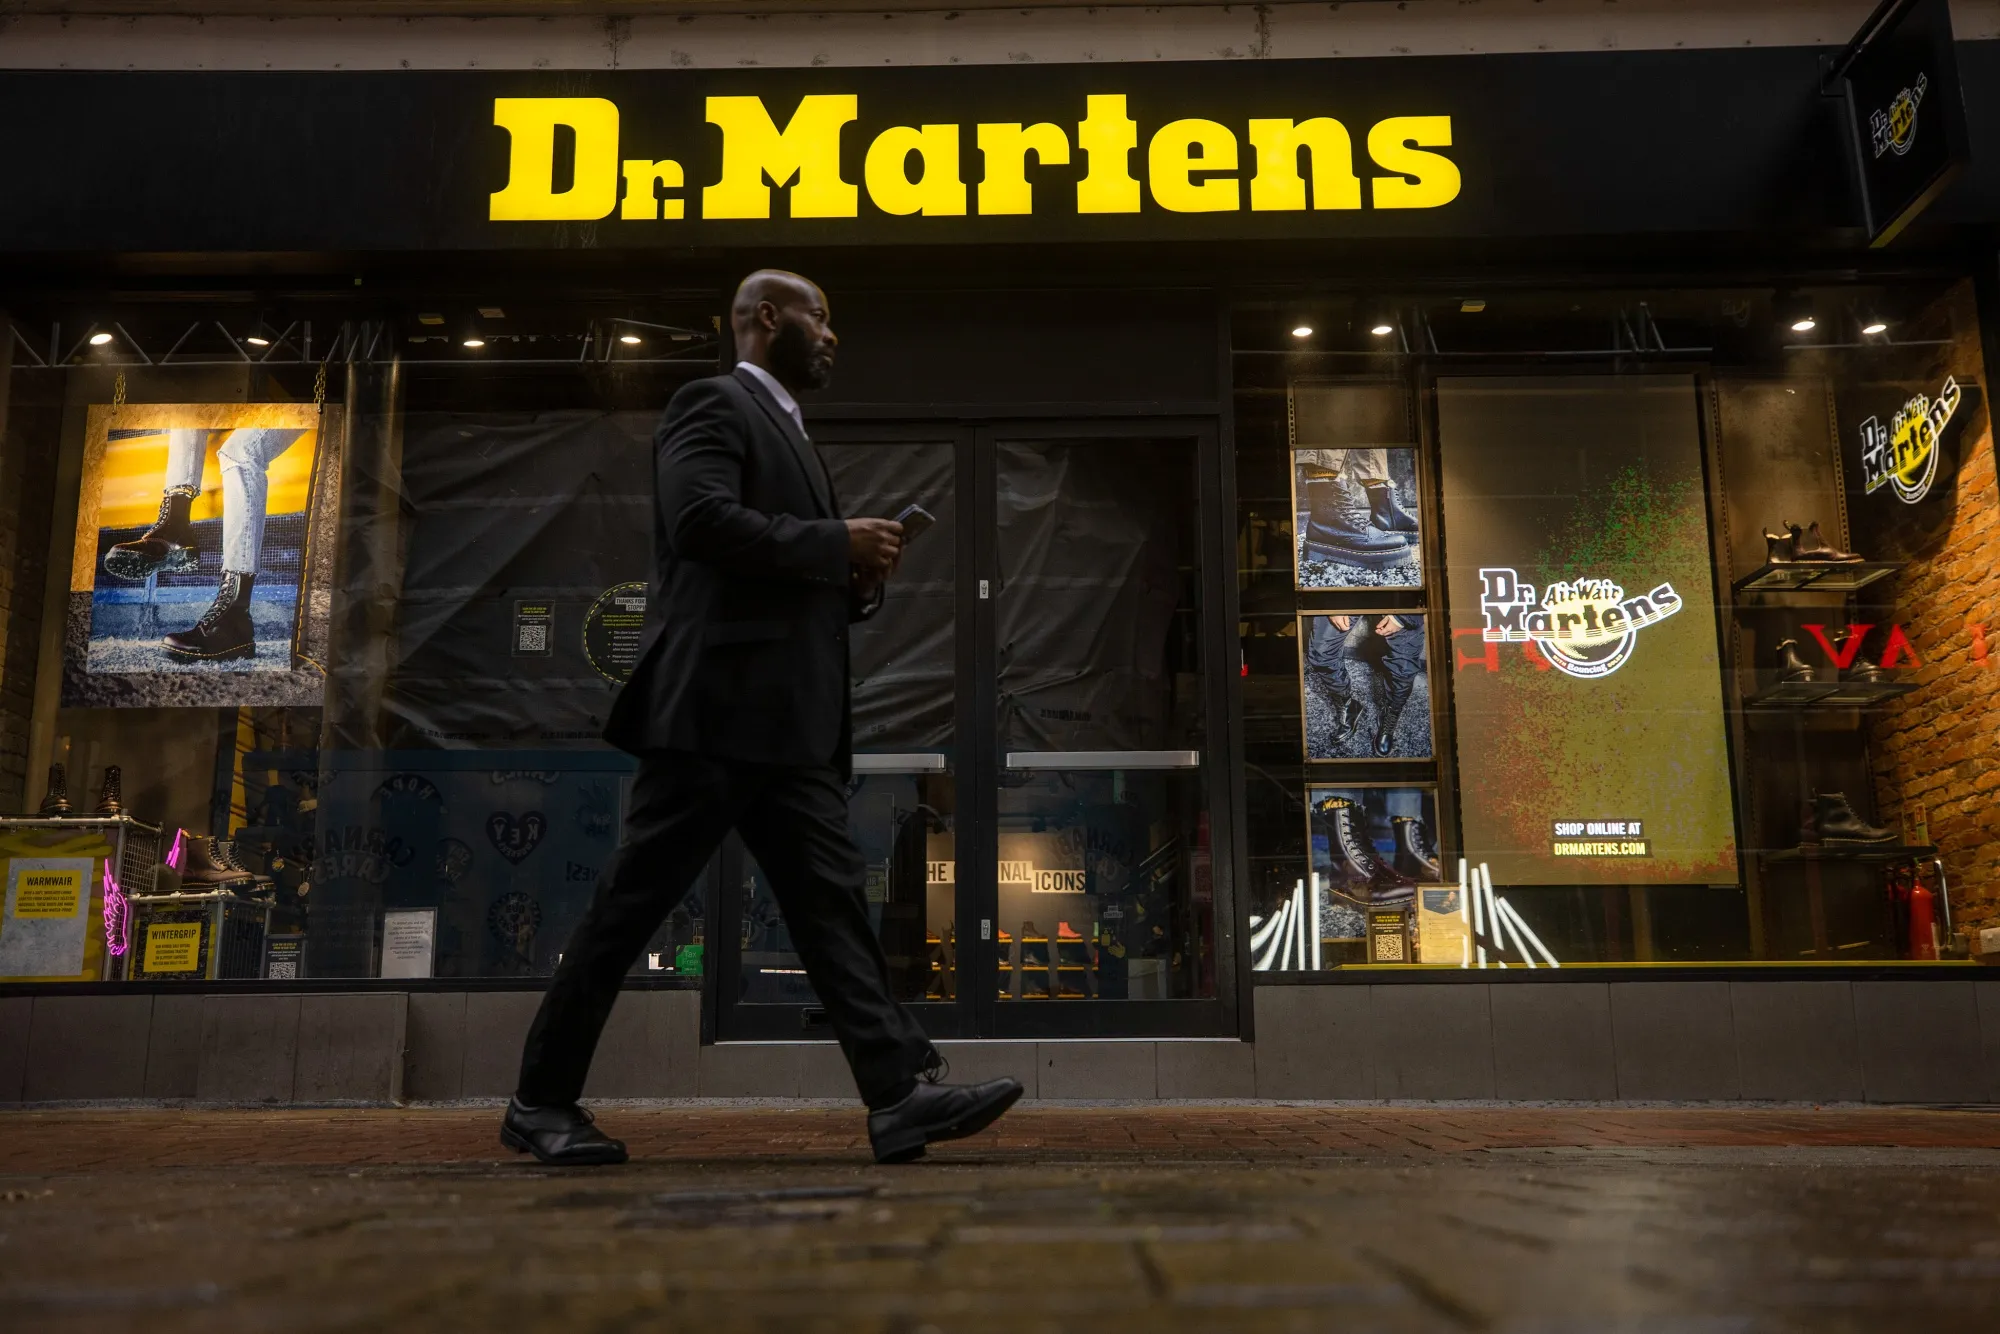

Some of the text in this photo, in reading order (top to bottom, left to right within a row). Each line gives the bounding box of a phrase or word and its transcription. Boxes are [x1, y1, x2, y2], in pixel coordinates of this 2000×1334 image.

[489, 94, 1462, 221] Dr. Martens
[1863, 375, 1961, 495] Martens
[1542, 577, 1624, 608] AirWair
[1482, 582, 1682, 642] Martens
[1567, 662, 1608, 674] Bouncing
[1554, 822, 1641, 836] SHOP ONLINE AT
[1554, 842, 1646, 856] DRMARTENS.COM
[26, 876, 73, 886] WARMWAIR
[927, 863, 947, 882] HE
[1035, 872, 1086, 891] ICONS
[151, 929, 197, 940] WINTERGRIP
